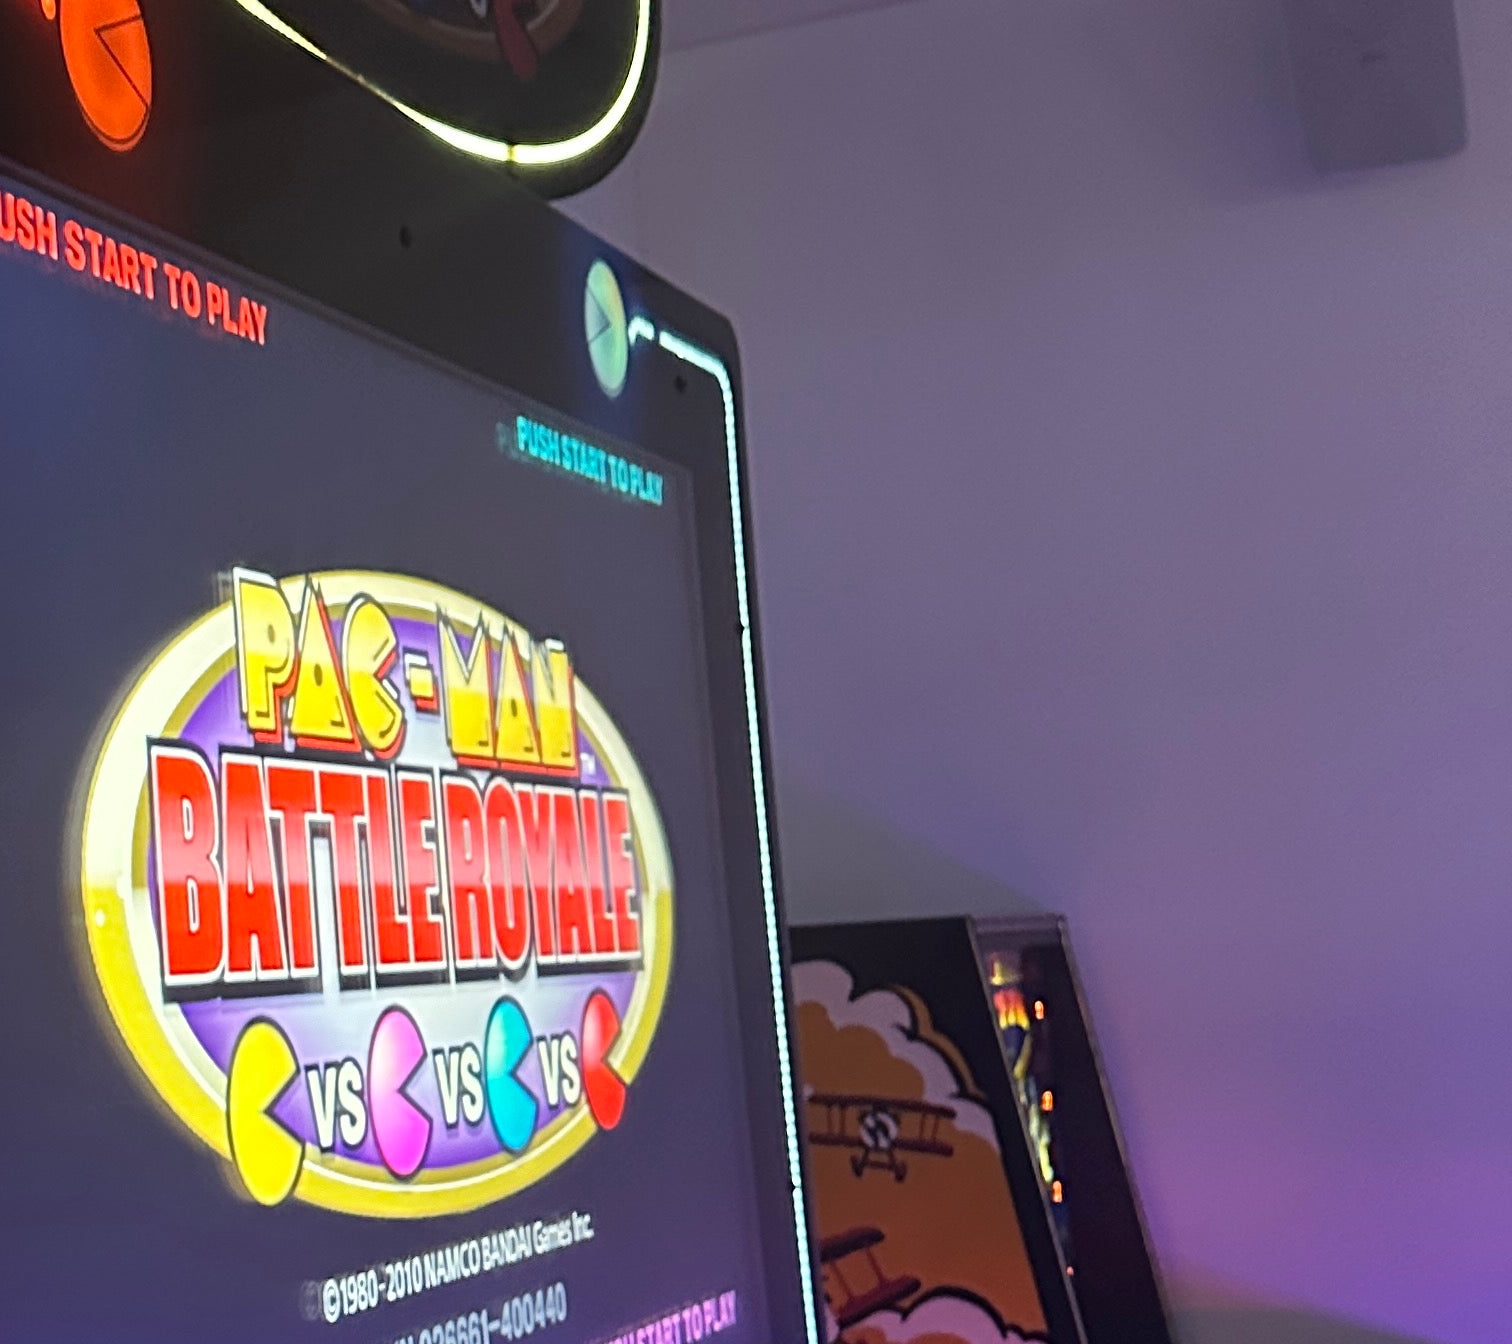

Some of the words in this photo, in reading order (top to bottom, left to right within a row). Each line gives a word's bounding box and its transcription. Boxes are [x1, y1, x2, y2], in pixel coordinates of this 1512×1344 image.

[64, 220, 157, 299] START
[163, 262, 201, 318] TO
[206, 282, 267, 345] PLAY
[516, 415, 561, 465] PUSH
[561, 434, 606, 483] START
[607, 454, 629, 492] TO
[629, 464, 663, 505] PLAY
[233, 567, 578, 778] PAC-MAN
[148, 742, 445, 988] BATTLE
[442, 776, 644, 974] ROYALE
[306, 1061, 366, 1150] VS
[433, 1042, 486, 1126] VS
[538, 1031, 582, 1107] VS
[424, 1239, 482, 1289] NAMCO
[482, 1221, 535, 1271] BANDAI
[533, 1219, 574, 1256] Games
[682, 1304, 703, 1344] TO
[702, 1289, 737, 1338] PLAY
